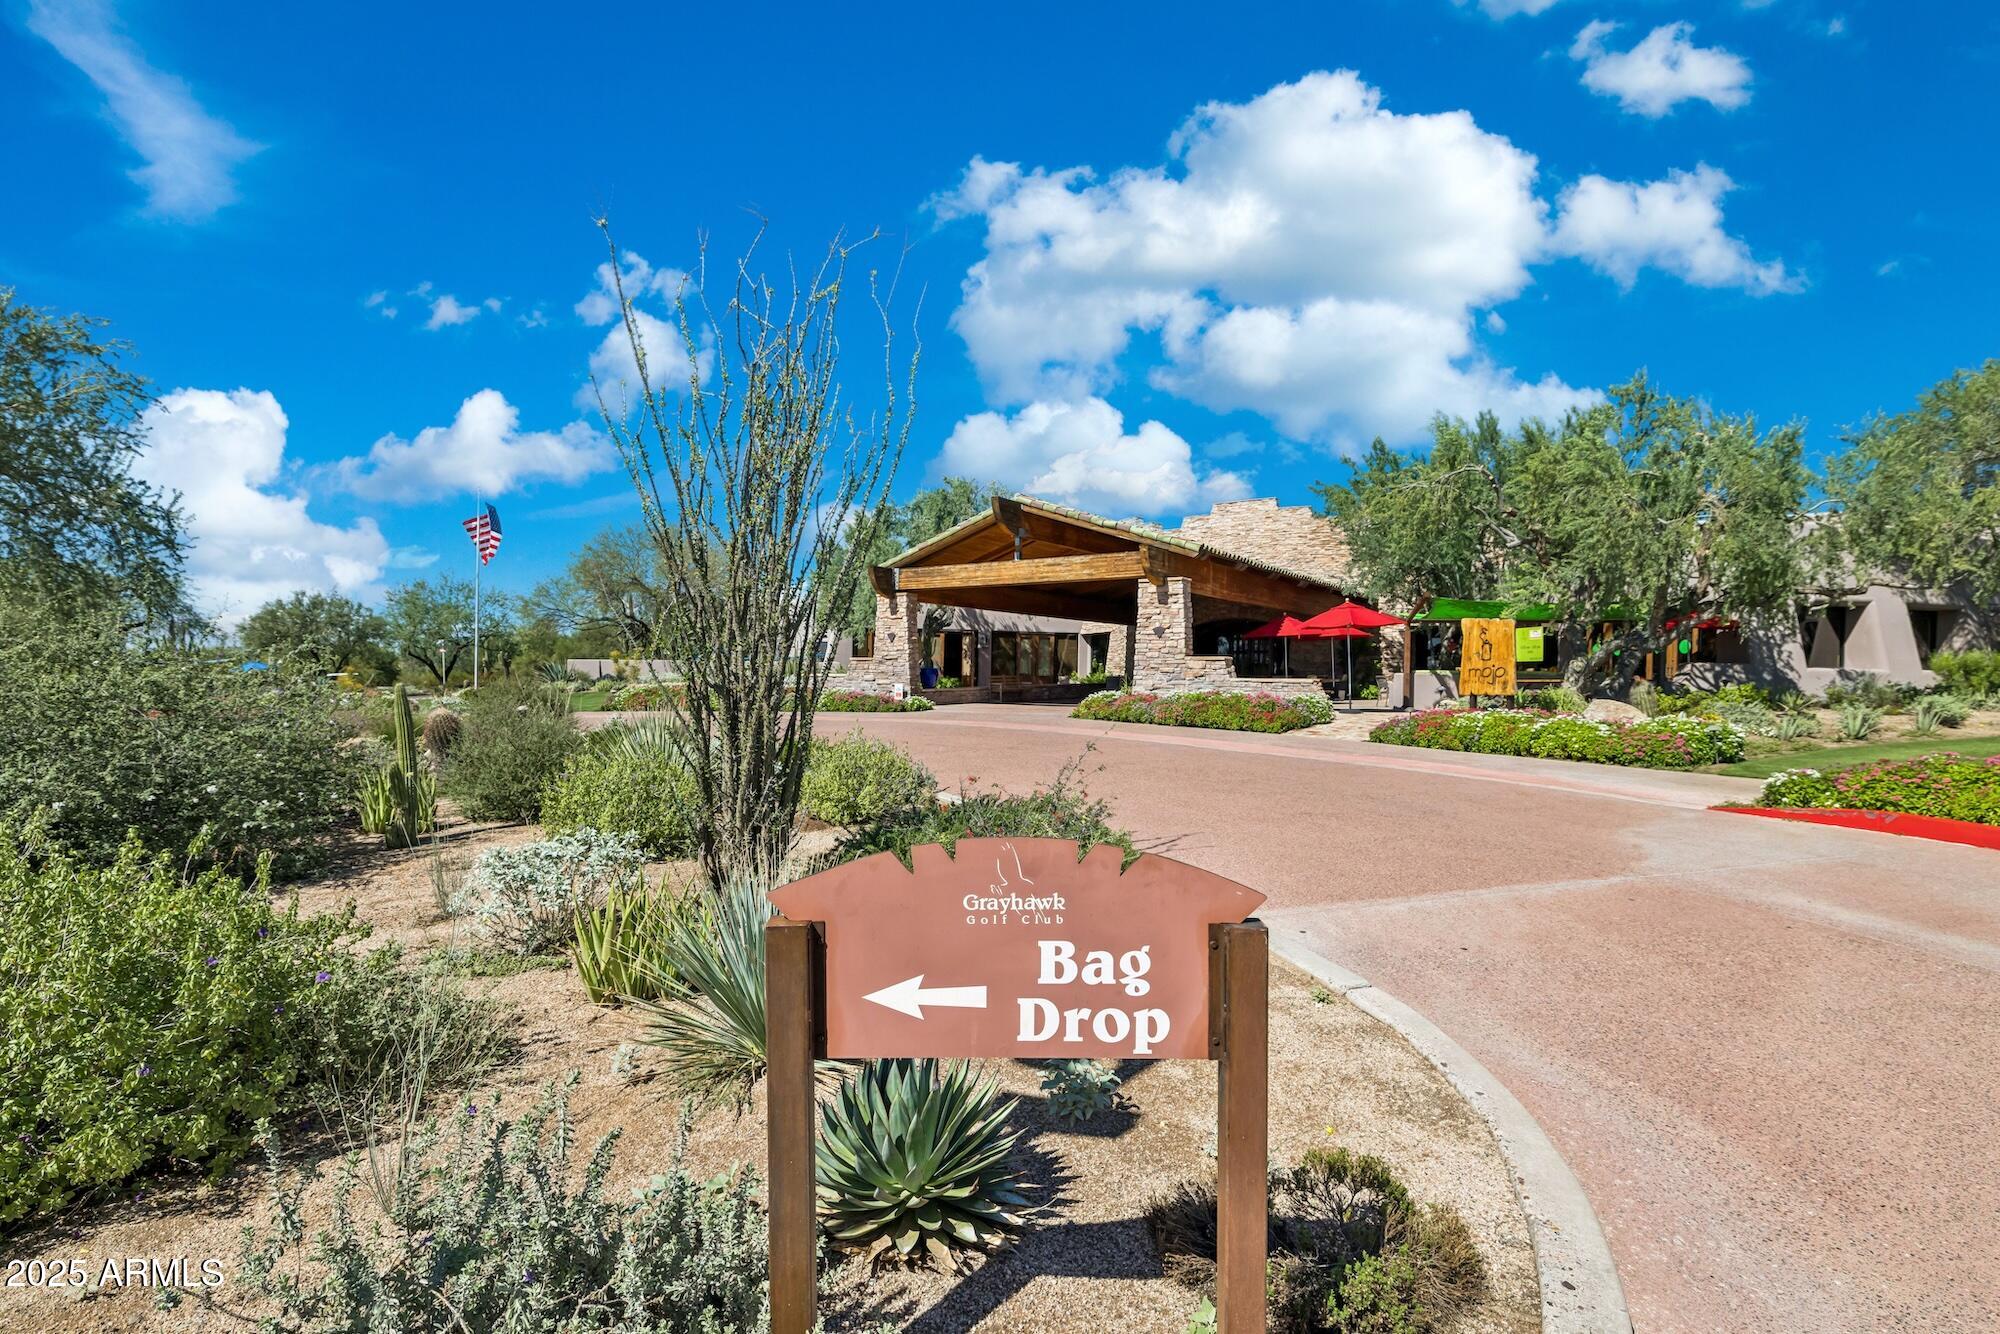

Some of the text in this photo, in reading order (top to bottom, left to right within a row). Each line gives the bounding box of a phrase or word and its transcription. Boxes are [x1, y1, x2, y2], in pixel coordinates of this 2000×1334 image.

[1468, 664, 1506, 686] mojo
[963, 892, 1066, 915] Grayhawk
[966, 914, 1064, 925] Golf Club
[1037, 940, 1152, 997] Bag
[1016, 997, 1171, 1055] Drop
